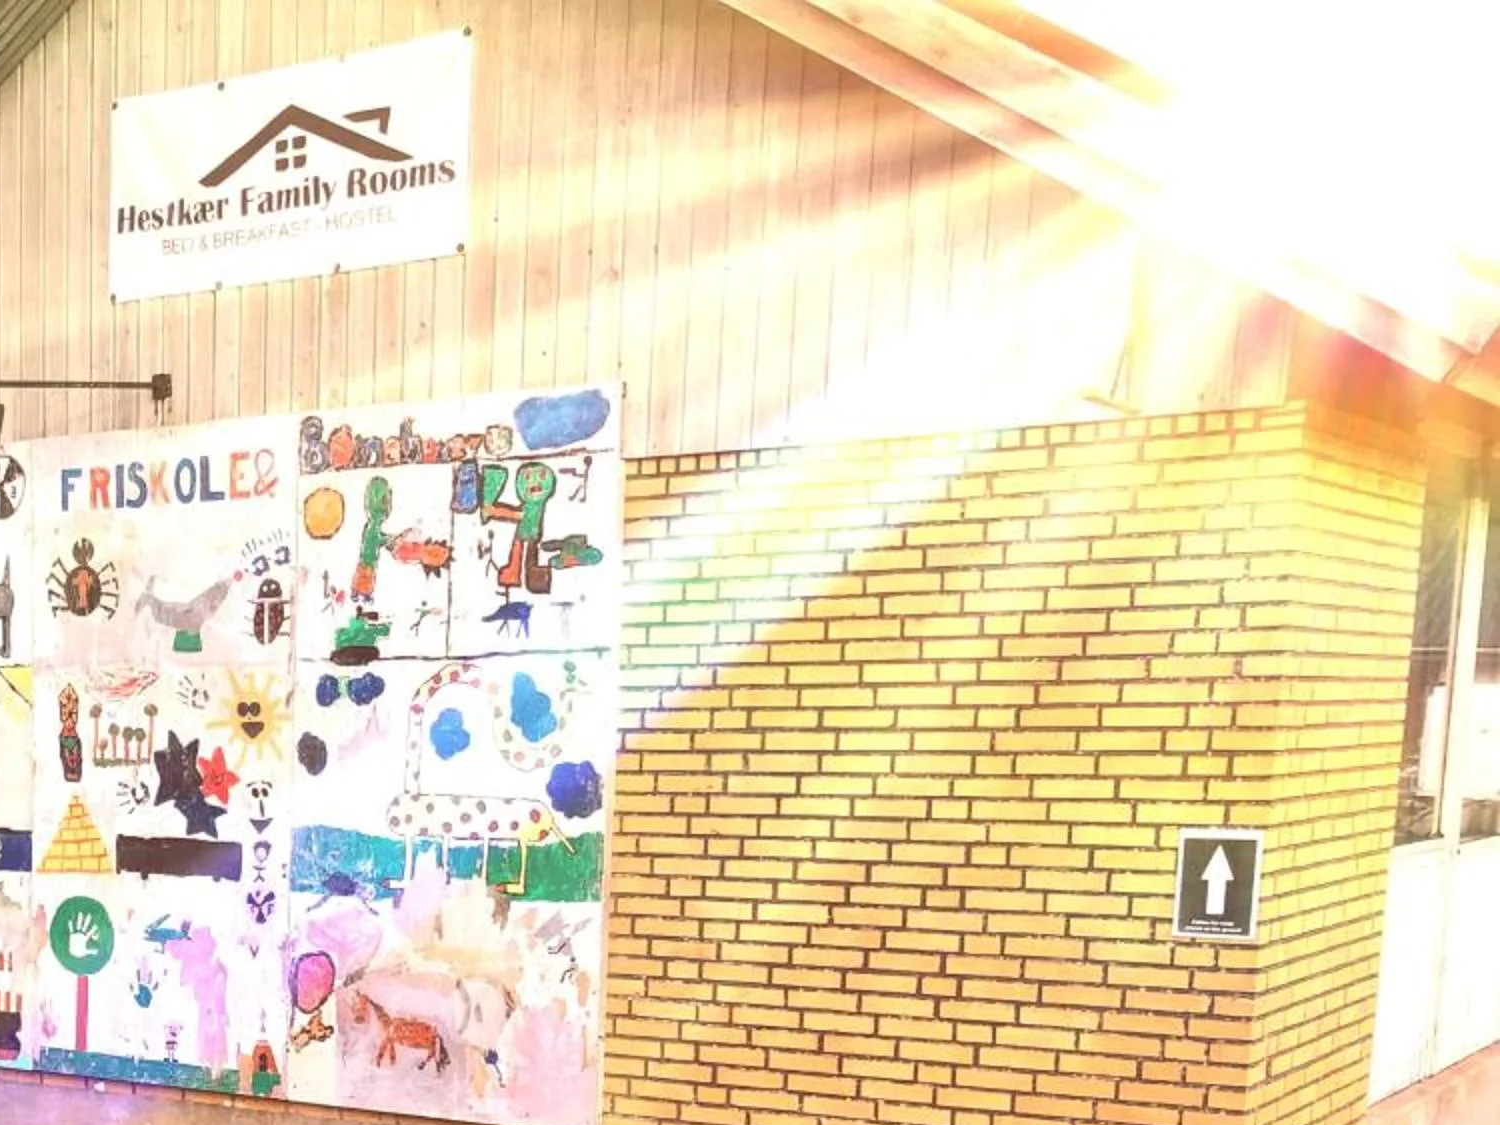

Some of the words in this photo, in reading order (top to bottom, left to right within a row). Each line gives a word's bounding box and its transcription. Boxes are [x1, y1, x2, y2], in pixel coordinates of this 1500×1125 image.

[116, 196, 229, 234] Hestkær
[240, 174, 337, 216] Family
[346, 158, 456, 199] Rooms
[198, 235, 209, 252] &
[212, 217, 311, 251] BREAKFAST
[325, 205, 397, 232] HOSTEL
[60, 451, 251, 513] FRISKOLE
